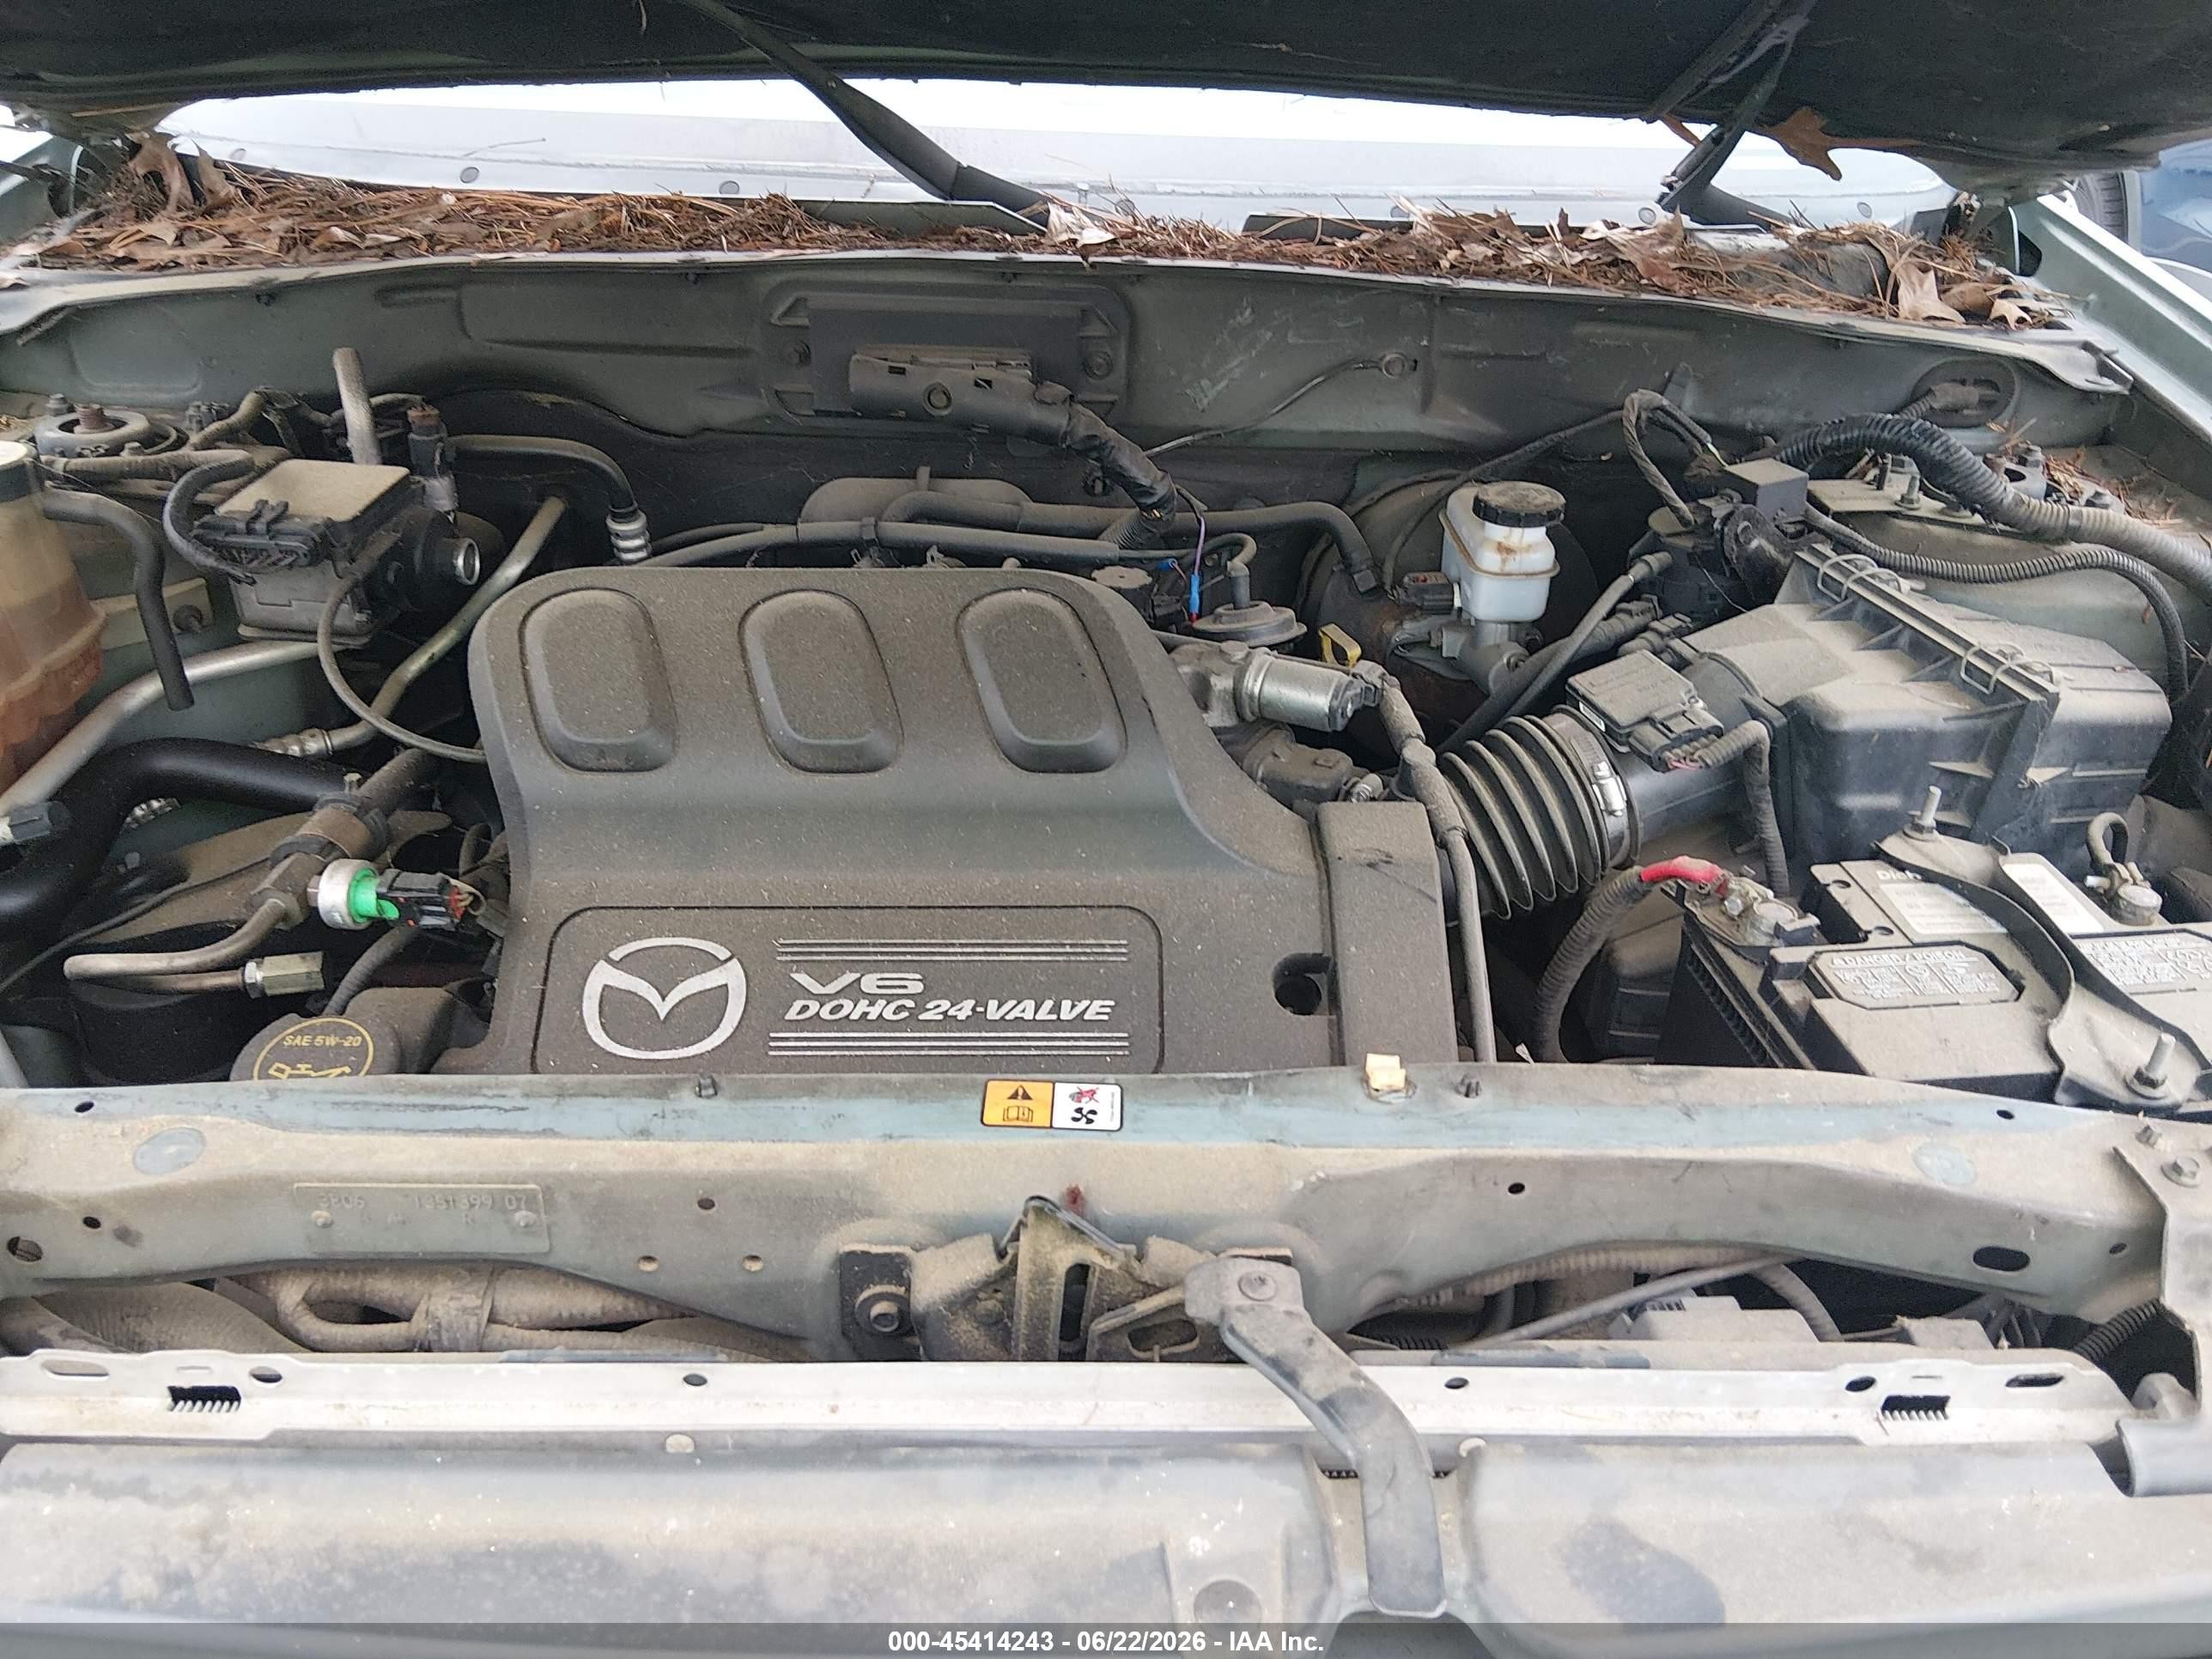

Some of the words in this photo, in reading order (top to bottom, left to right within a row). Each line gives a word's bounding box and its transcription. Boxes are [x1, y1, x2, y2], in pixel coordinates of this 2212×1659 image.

[789, 972, 924, 994] V6
[784, 999, 915, 1021] DOHC
[918, 999, 1115, 1021] 24-VALVE
[283, 1035, 313, 1047] SAE
[314, 1035, 362, 1047] 5W-20
